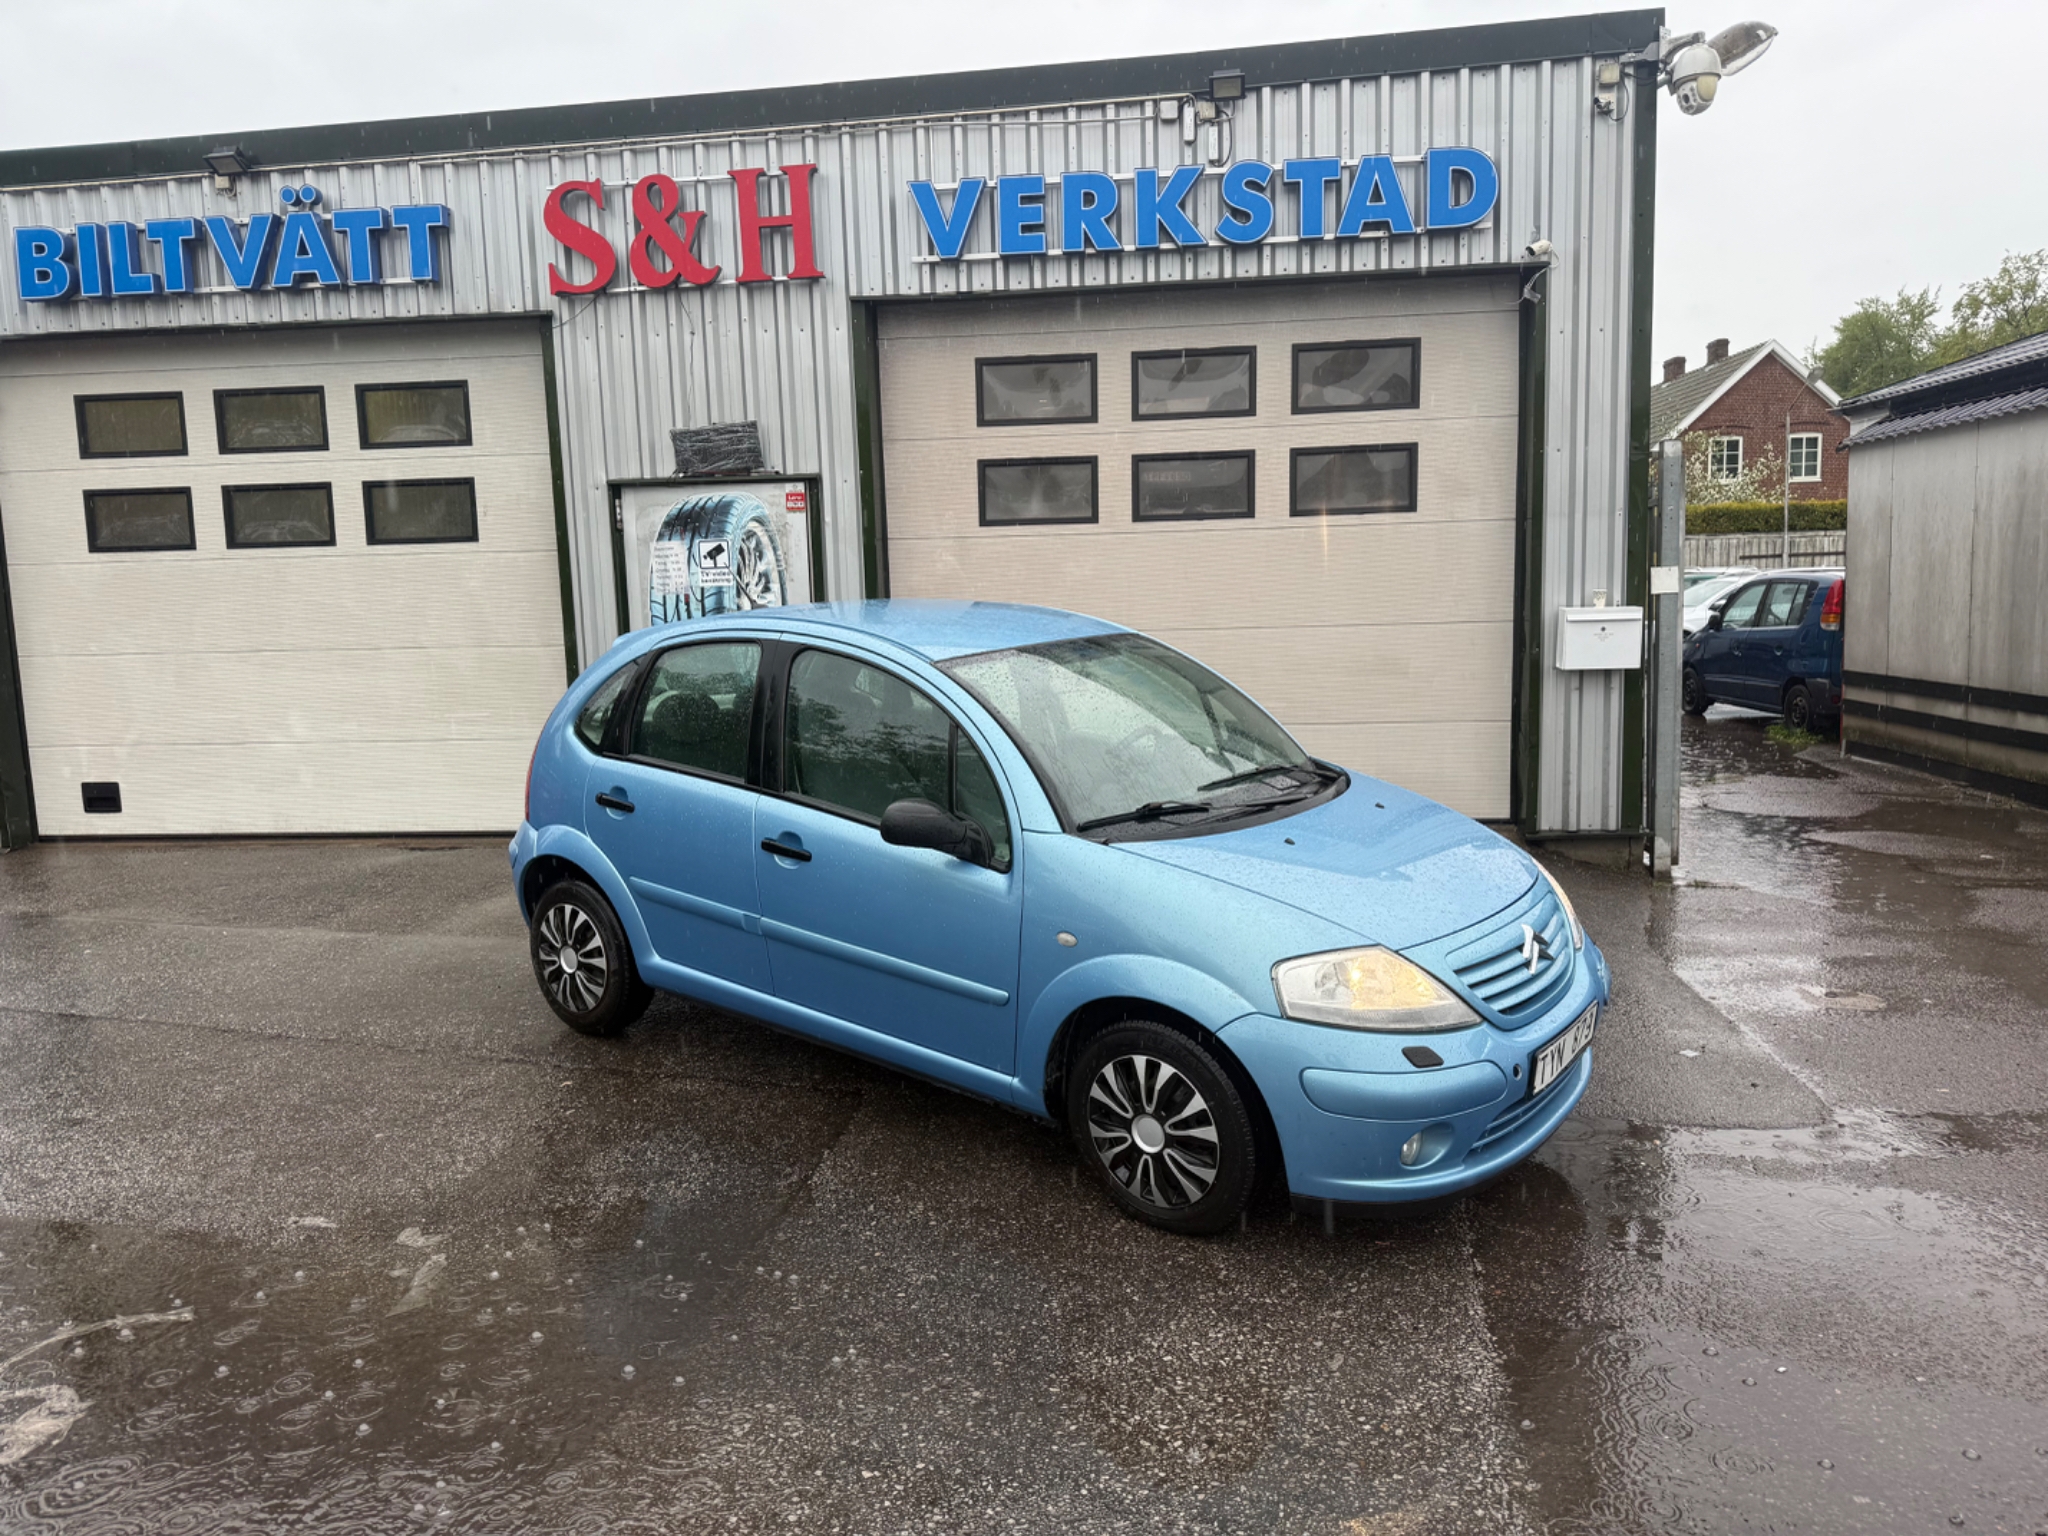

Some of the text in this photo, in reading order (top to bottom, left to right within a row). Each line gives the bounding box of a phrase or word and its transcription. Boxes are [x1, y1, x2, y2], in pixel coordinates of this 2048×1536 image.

[13, 185, 450, 302] BILTVÄTT
[543, 163, 826, 296] S&H
[907, 147, 1500, 260] VERKSTAD
[1538, 1037, 1567, 1085] TYN
